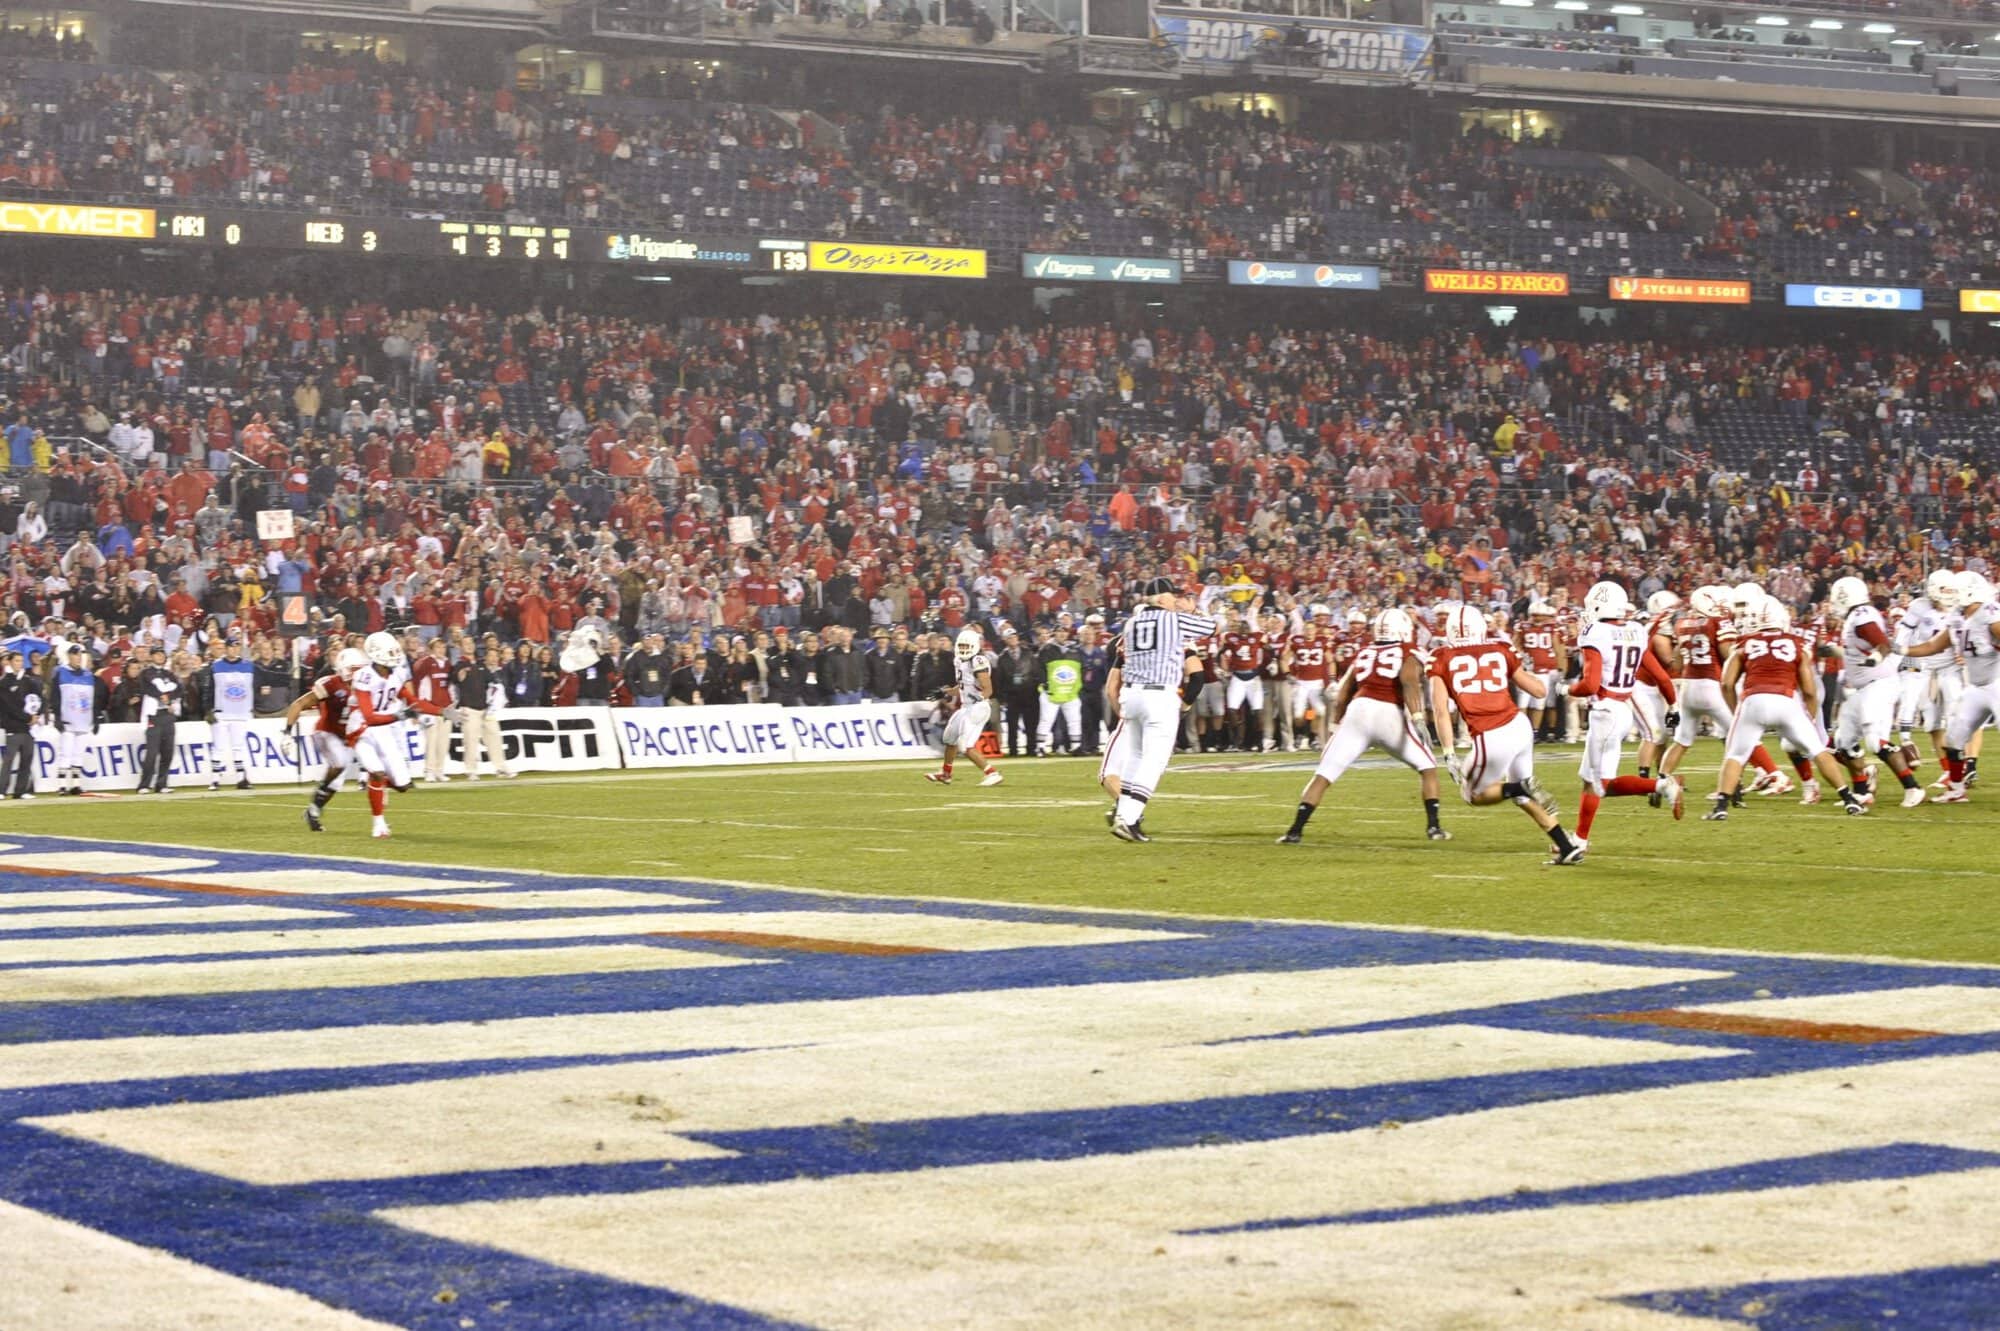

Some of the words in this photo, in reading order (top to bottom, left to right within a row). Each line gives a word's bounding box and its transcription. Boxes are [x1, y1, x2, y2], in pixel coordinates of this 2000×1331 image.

[1306, 28, 1405, 76] ISION
[0, 204, 145, 235] CYMER
[362, 231, 377, 251] 3
[486, 236, 501, 256] 3
[697, 250, 750, 262] SEAFOOD
[901, 250, 970, 271] Pizza
[1428, 273, 1498, 291] WELLS
[1500, 275, 1566, 292] FARGO
[1697, 286, 1747, 298] RESORT
[1296, 648, 1325, 666] 33
[1354, 646, 1404, 682] 99
[1608, 645, 1641, 689] 19
[1449, 652, 1509, 694] 23
